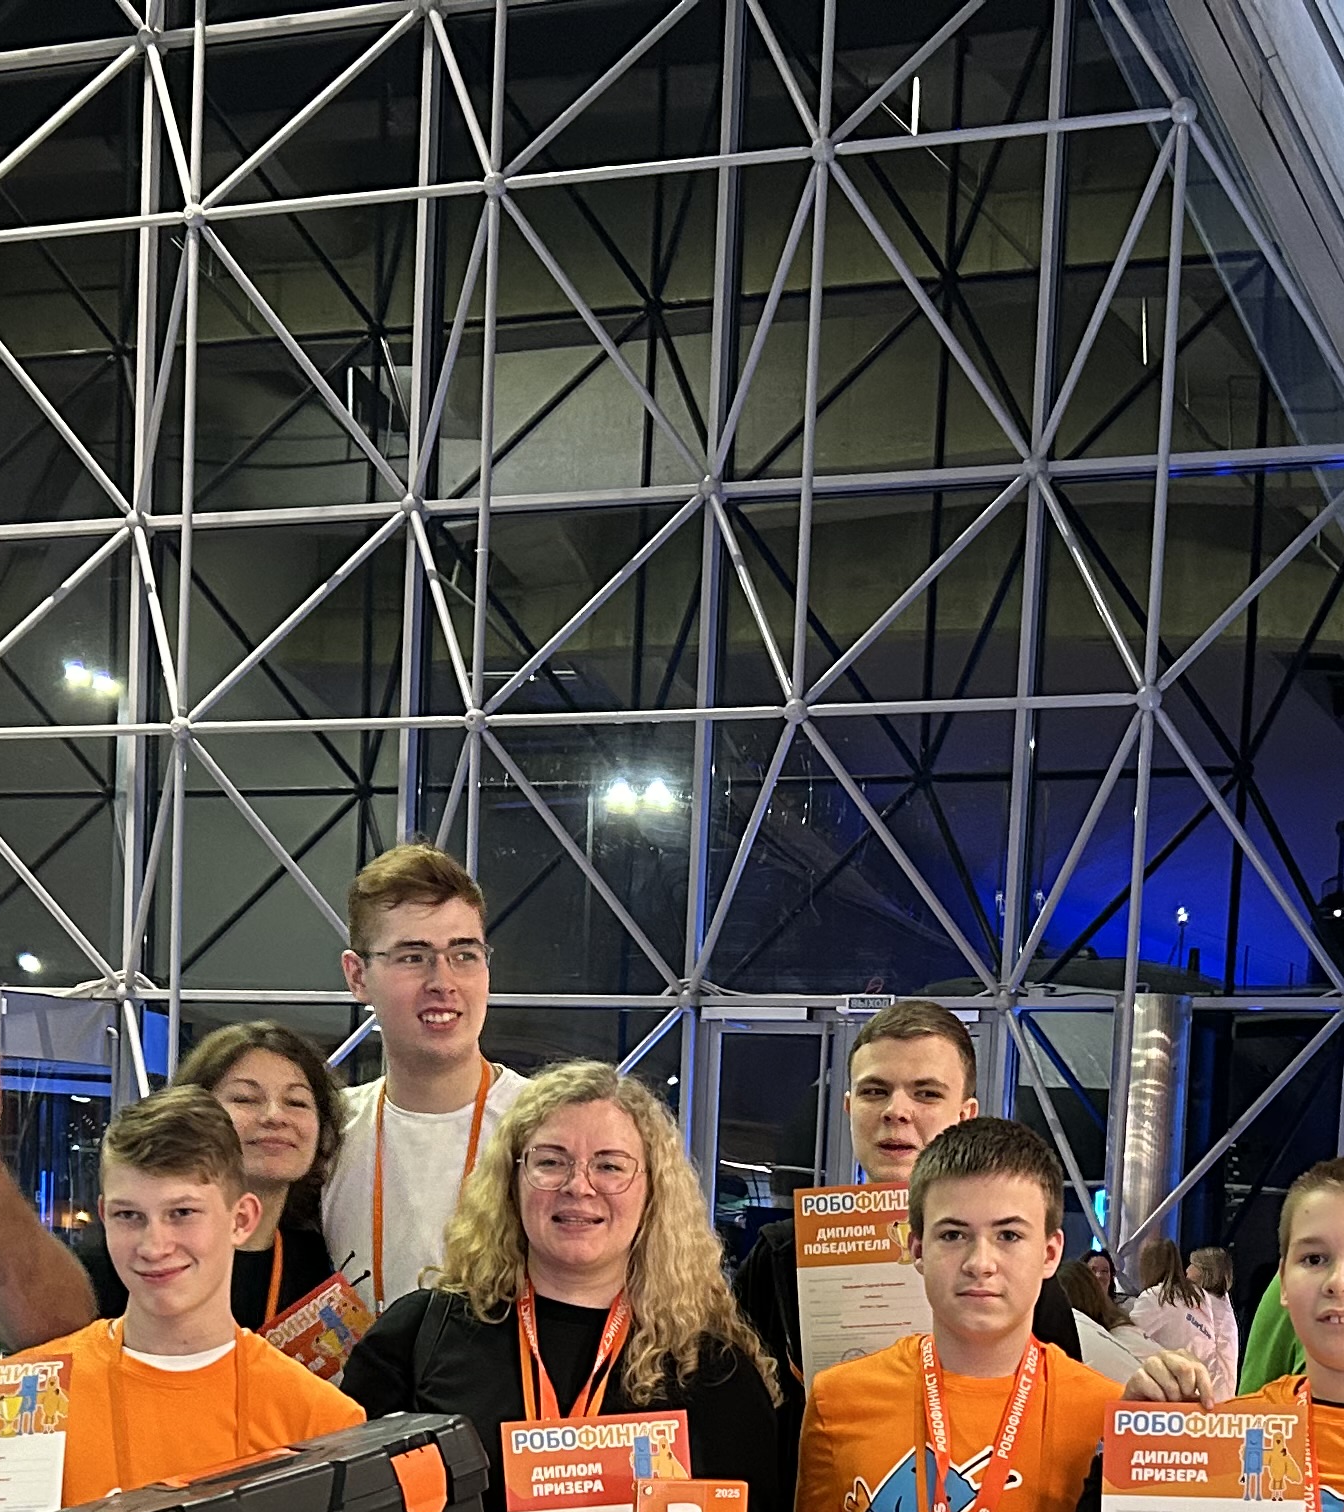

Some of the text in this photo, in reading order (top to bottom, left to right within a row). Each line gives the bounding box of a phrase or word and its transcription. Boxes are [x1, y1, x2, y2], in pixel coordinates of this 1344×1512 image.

[850, 998, 890, 1009] ВЫХОД
[802, 1189, 909, 1216] РОБОФИН
[816, 1225, 876, 1241] ДИПЛОМ
[804, 1238, 891, 1255] ПОБЕДИТЕЛЯ
[920, 1341, 948, 1453] РОБОФИНИСТ 2025
[997, 1346, 1040, 1459] РОБОФИНИСТ 2025
[1114, 1410, 1298, 1440] РОБОФИНИСТ
[511, 1420, 679, 1454] РОБОФИНИСТ
[1130, 1450, 1208, 1466] ДИПЛОМ
[531, 1463, 603, 1482] ДИПЛОМ
[1131, 1468, 1209, 1482] ПРИЗЕРА
[532, 1480, 605, 1497] ПРИЗЕРА
[715, 1488, 741, 1498] 2025
